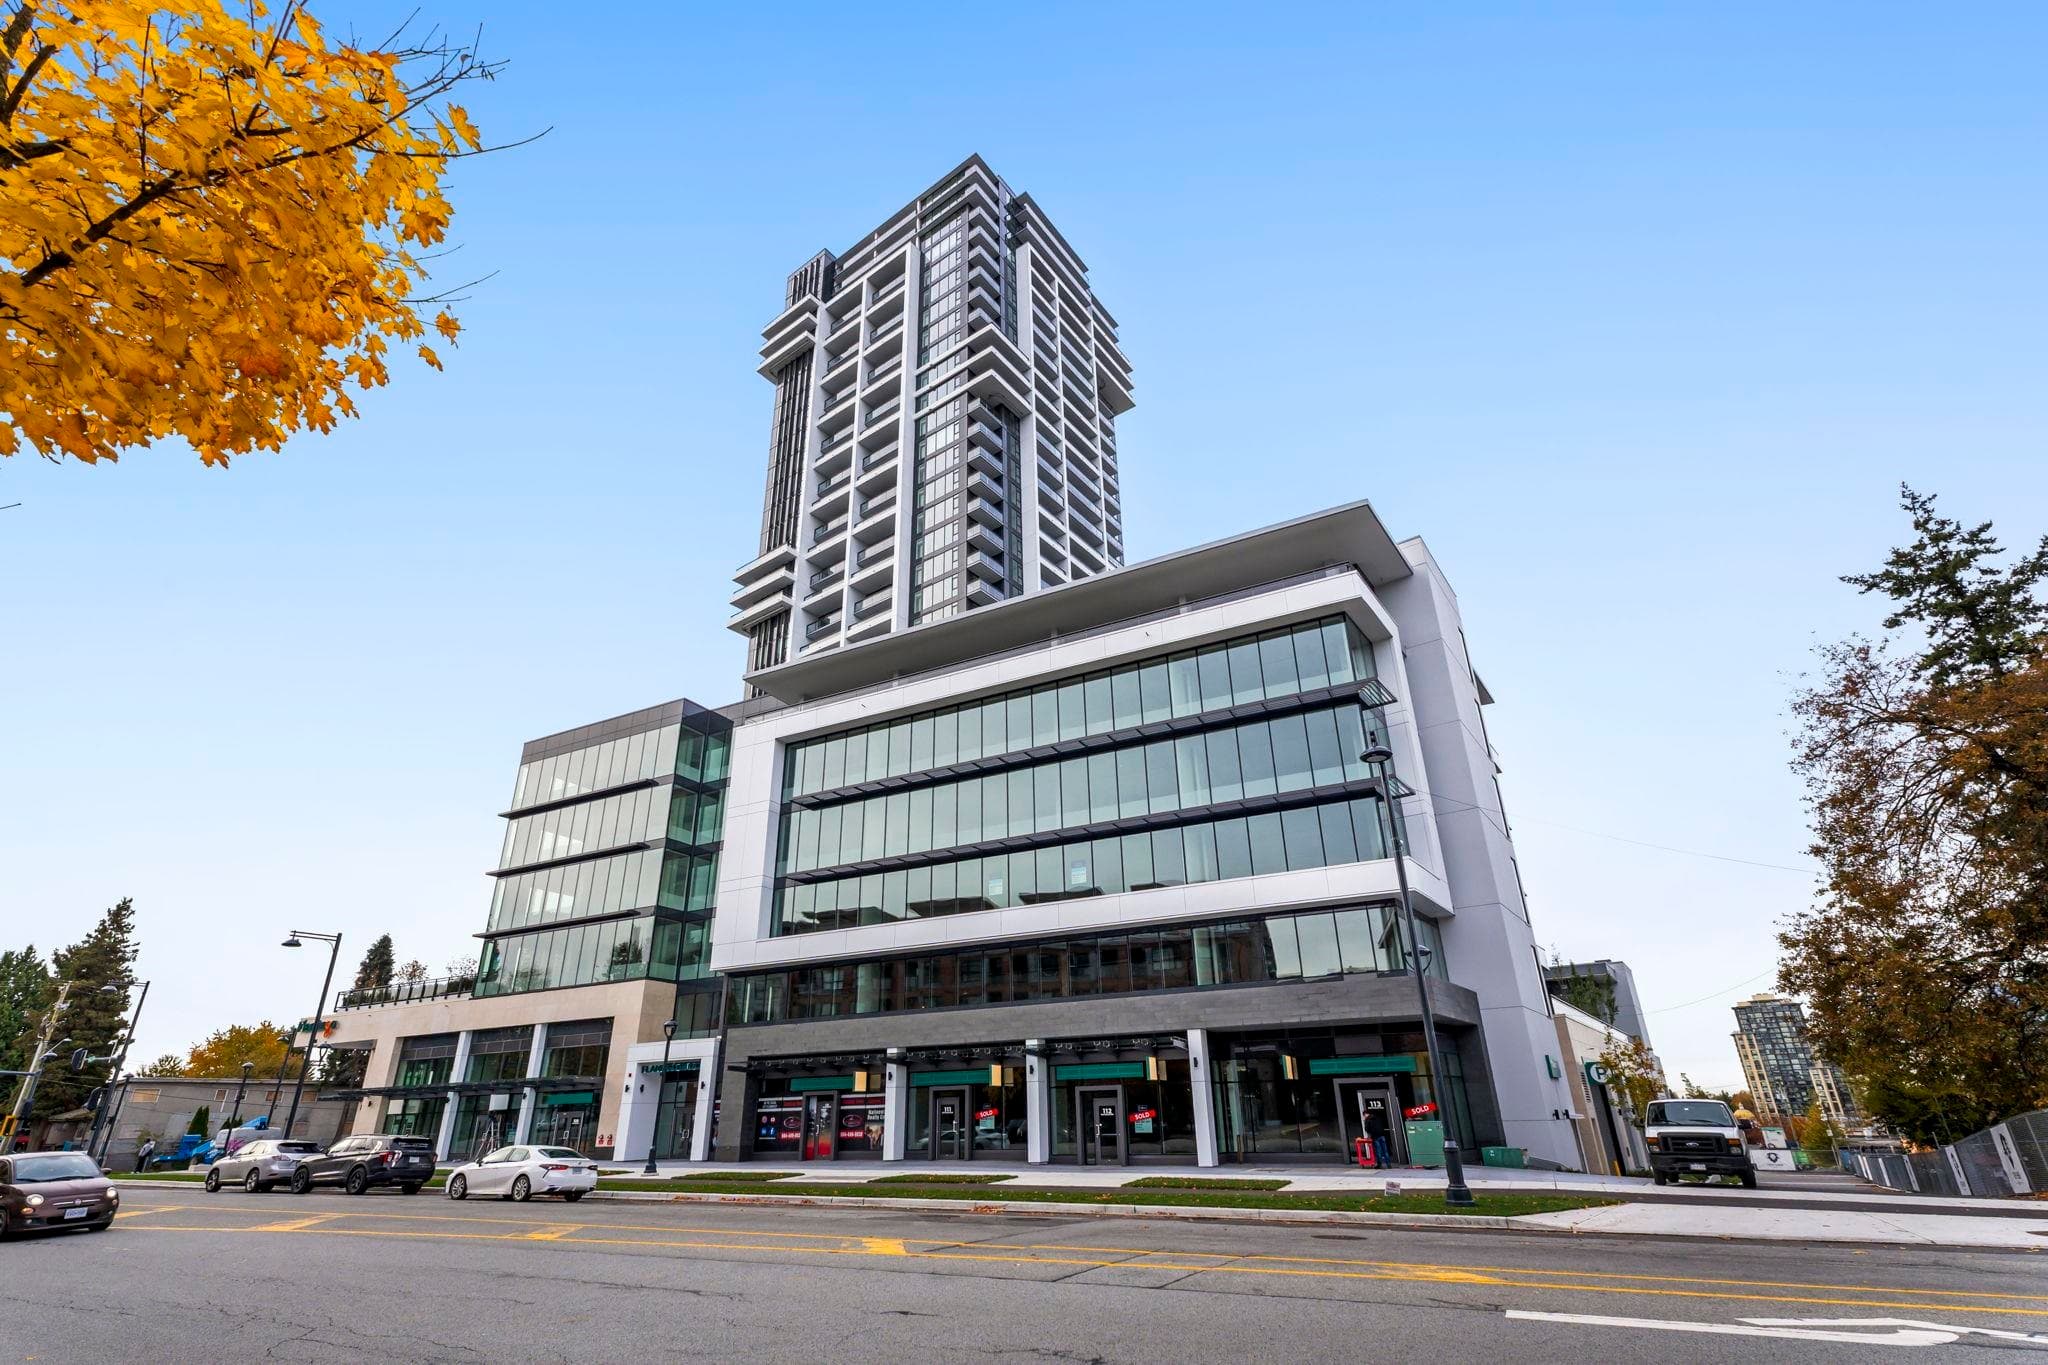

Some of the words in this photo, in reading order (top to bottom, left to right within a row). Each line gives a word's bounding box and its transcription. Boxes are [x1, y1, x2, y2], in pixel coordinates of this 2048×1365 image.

[1595, 1067, 1607, 1079] P
[980, 1110, 994, 1118] SOLD
[1412, 1105, 1430, 1115] SOLD
[1134, 1112, 1150, 1120] SOLD
